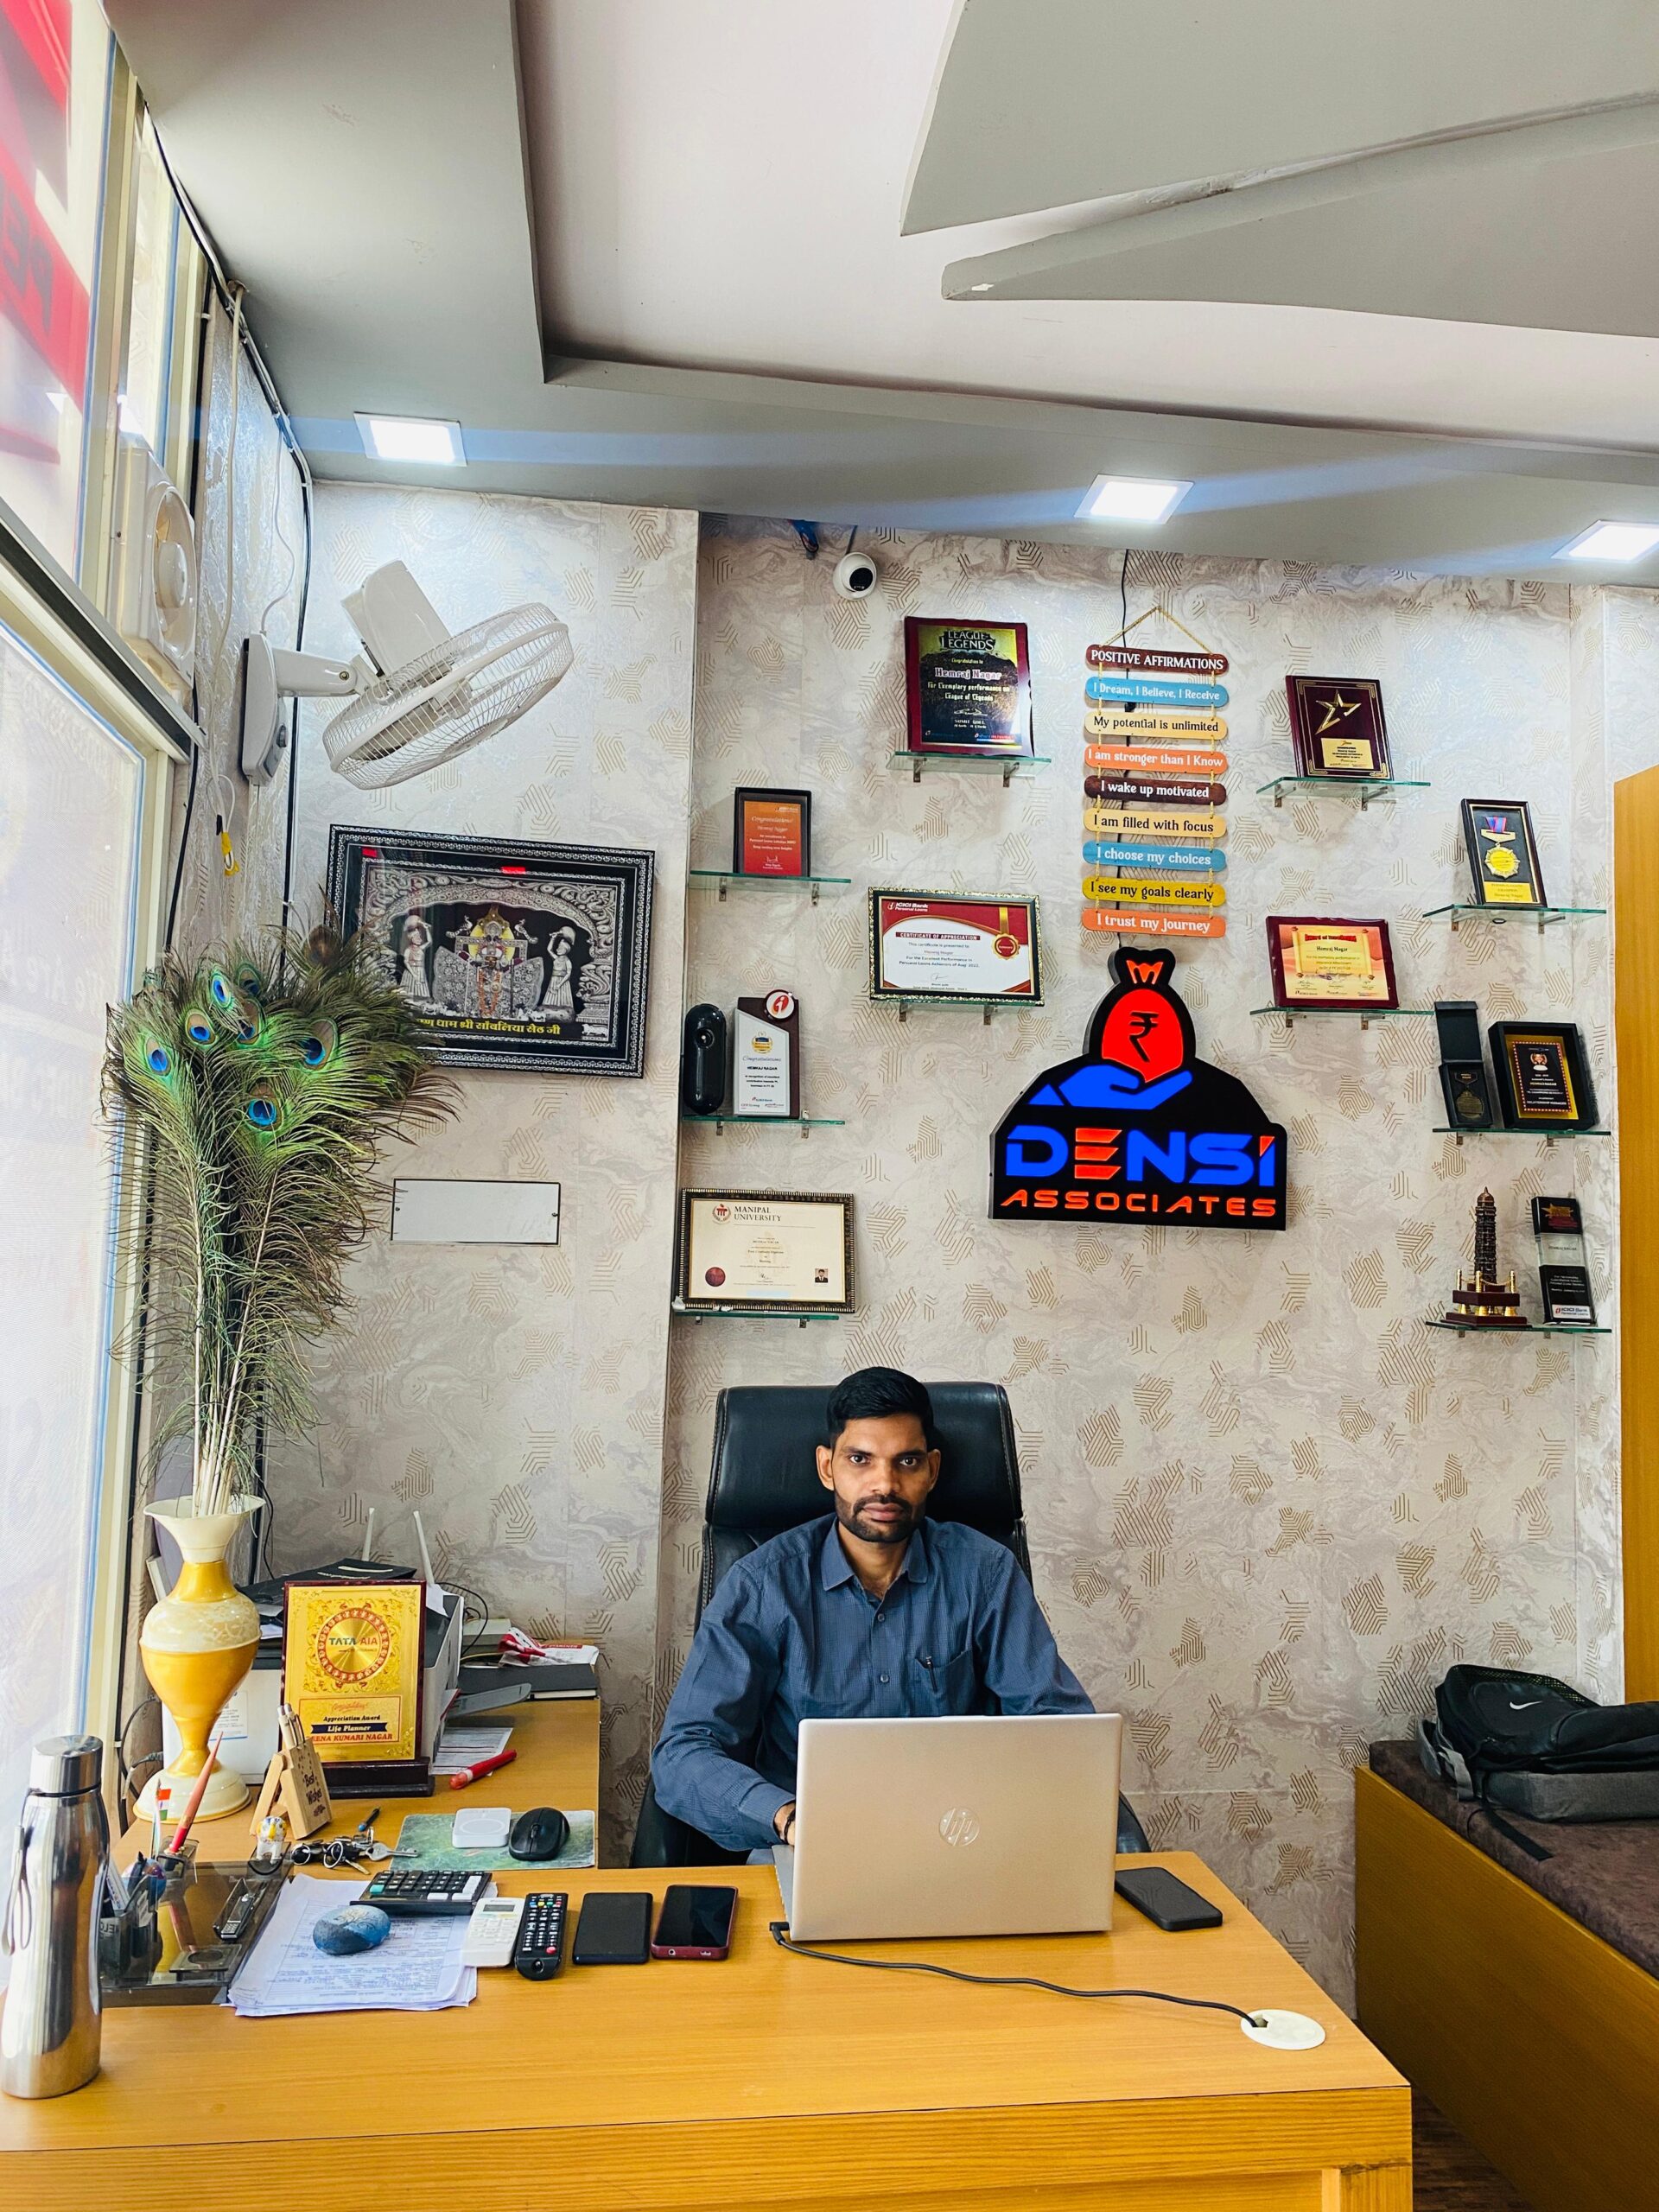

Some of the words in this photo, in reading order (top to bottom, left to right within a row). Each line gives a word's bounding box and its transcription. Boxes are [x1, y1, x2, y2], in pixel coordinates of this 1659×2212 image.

[948, 630, 986, 640] LEAGUE
[942, 636, 994, 652] LEGENDS
[1091, 650, 1141, 665] POSITIVE
[1143, 655, 1224, 670] AFFIRMATIONS
[935, 667, 970, 679] Hemraj
[971, 670, 1002, 681] Nagar
[1093, 683, 1096, 692] I
[1099, 683, 1133, 696] Dream,
[1135, 685, 1139, 695] I
[1141, 686, 1176, 698] Believe,
[1179, 689, 1182, 698] I
[1185, 690, 1220, 700] Receive
[1094, 715, 1109, 729] My
[1113, 718, 1156, 729] potential
[1160, 720, 1167, 729] is
[1172, 720, 1218, 732] unlimited
[1089, 749, 1091, 759] I
[1095, 752, 1110, 760] am
[1114, 751, 1158, 766] stronger
[1160, 753, 1184, 765] than
[1187, 755, 1190, 765] I
[1193, 755, 1223, 766] Know
[1101, 780, 1104, 791] I
[1108, 782, 1136, 793] wake
[1140, 785, 1154, 797] up
[1156, 785, 1209, 798] motivated
[1094, 815, 1097, 825] I
[1101, 818, 1118, 827] am
[1123, 817, 1149, 829] filled
[1154, 820, 1179, 830] with
[1183, 821, 1213, 832] focus
[1097, 847, 1101, 858] I
[1104, 849, 1143, 861] choose
[1147, 853, 1165, 865] my
[1168, 852, 1211, 865] choices
[1091, 881, 1094, 892] I
[1098, 885, 1116, 893] see
[1120, 886, 1137, 898] my
[1141, 886, 1170, 899] goals
[1175, 887, 1214, 902] clearly
[1096, 913, 1101, 925] I
[1105, 915, 1136, 927] trust
[1141, 920, 1160, 932] my
[1161, 918, 1211, 934] journey
[436, 1019, 457, 1028] धाम
[460, 1019, 474, 1030] श्री
[526, 1023, 545, 1034] सेठ
[546, 1024, 561, 1035] जी
[1001, 1189, 1276, 1217] ASSOCIATES
[303, 1770, 315, 1788] Best
